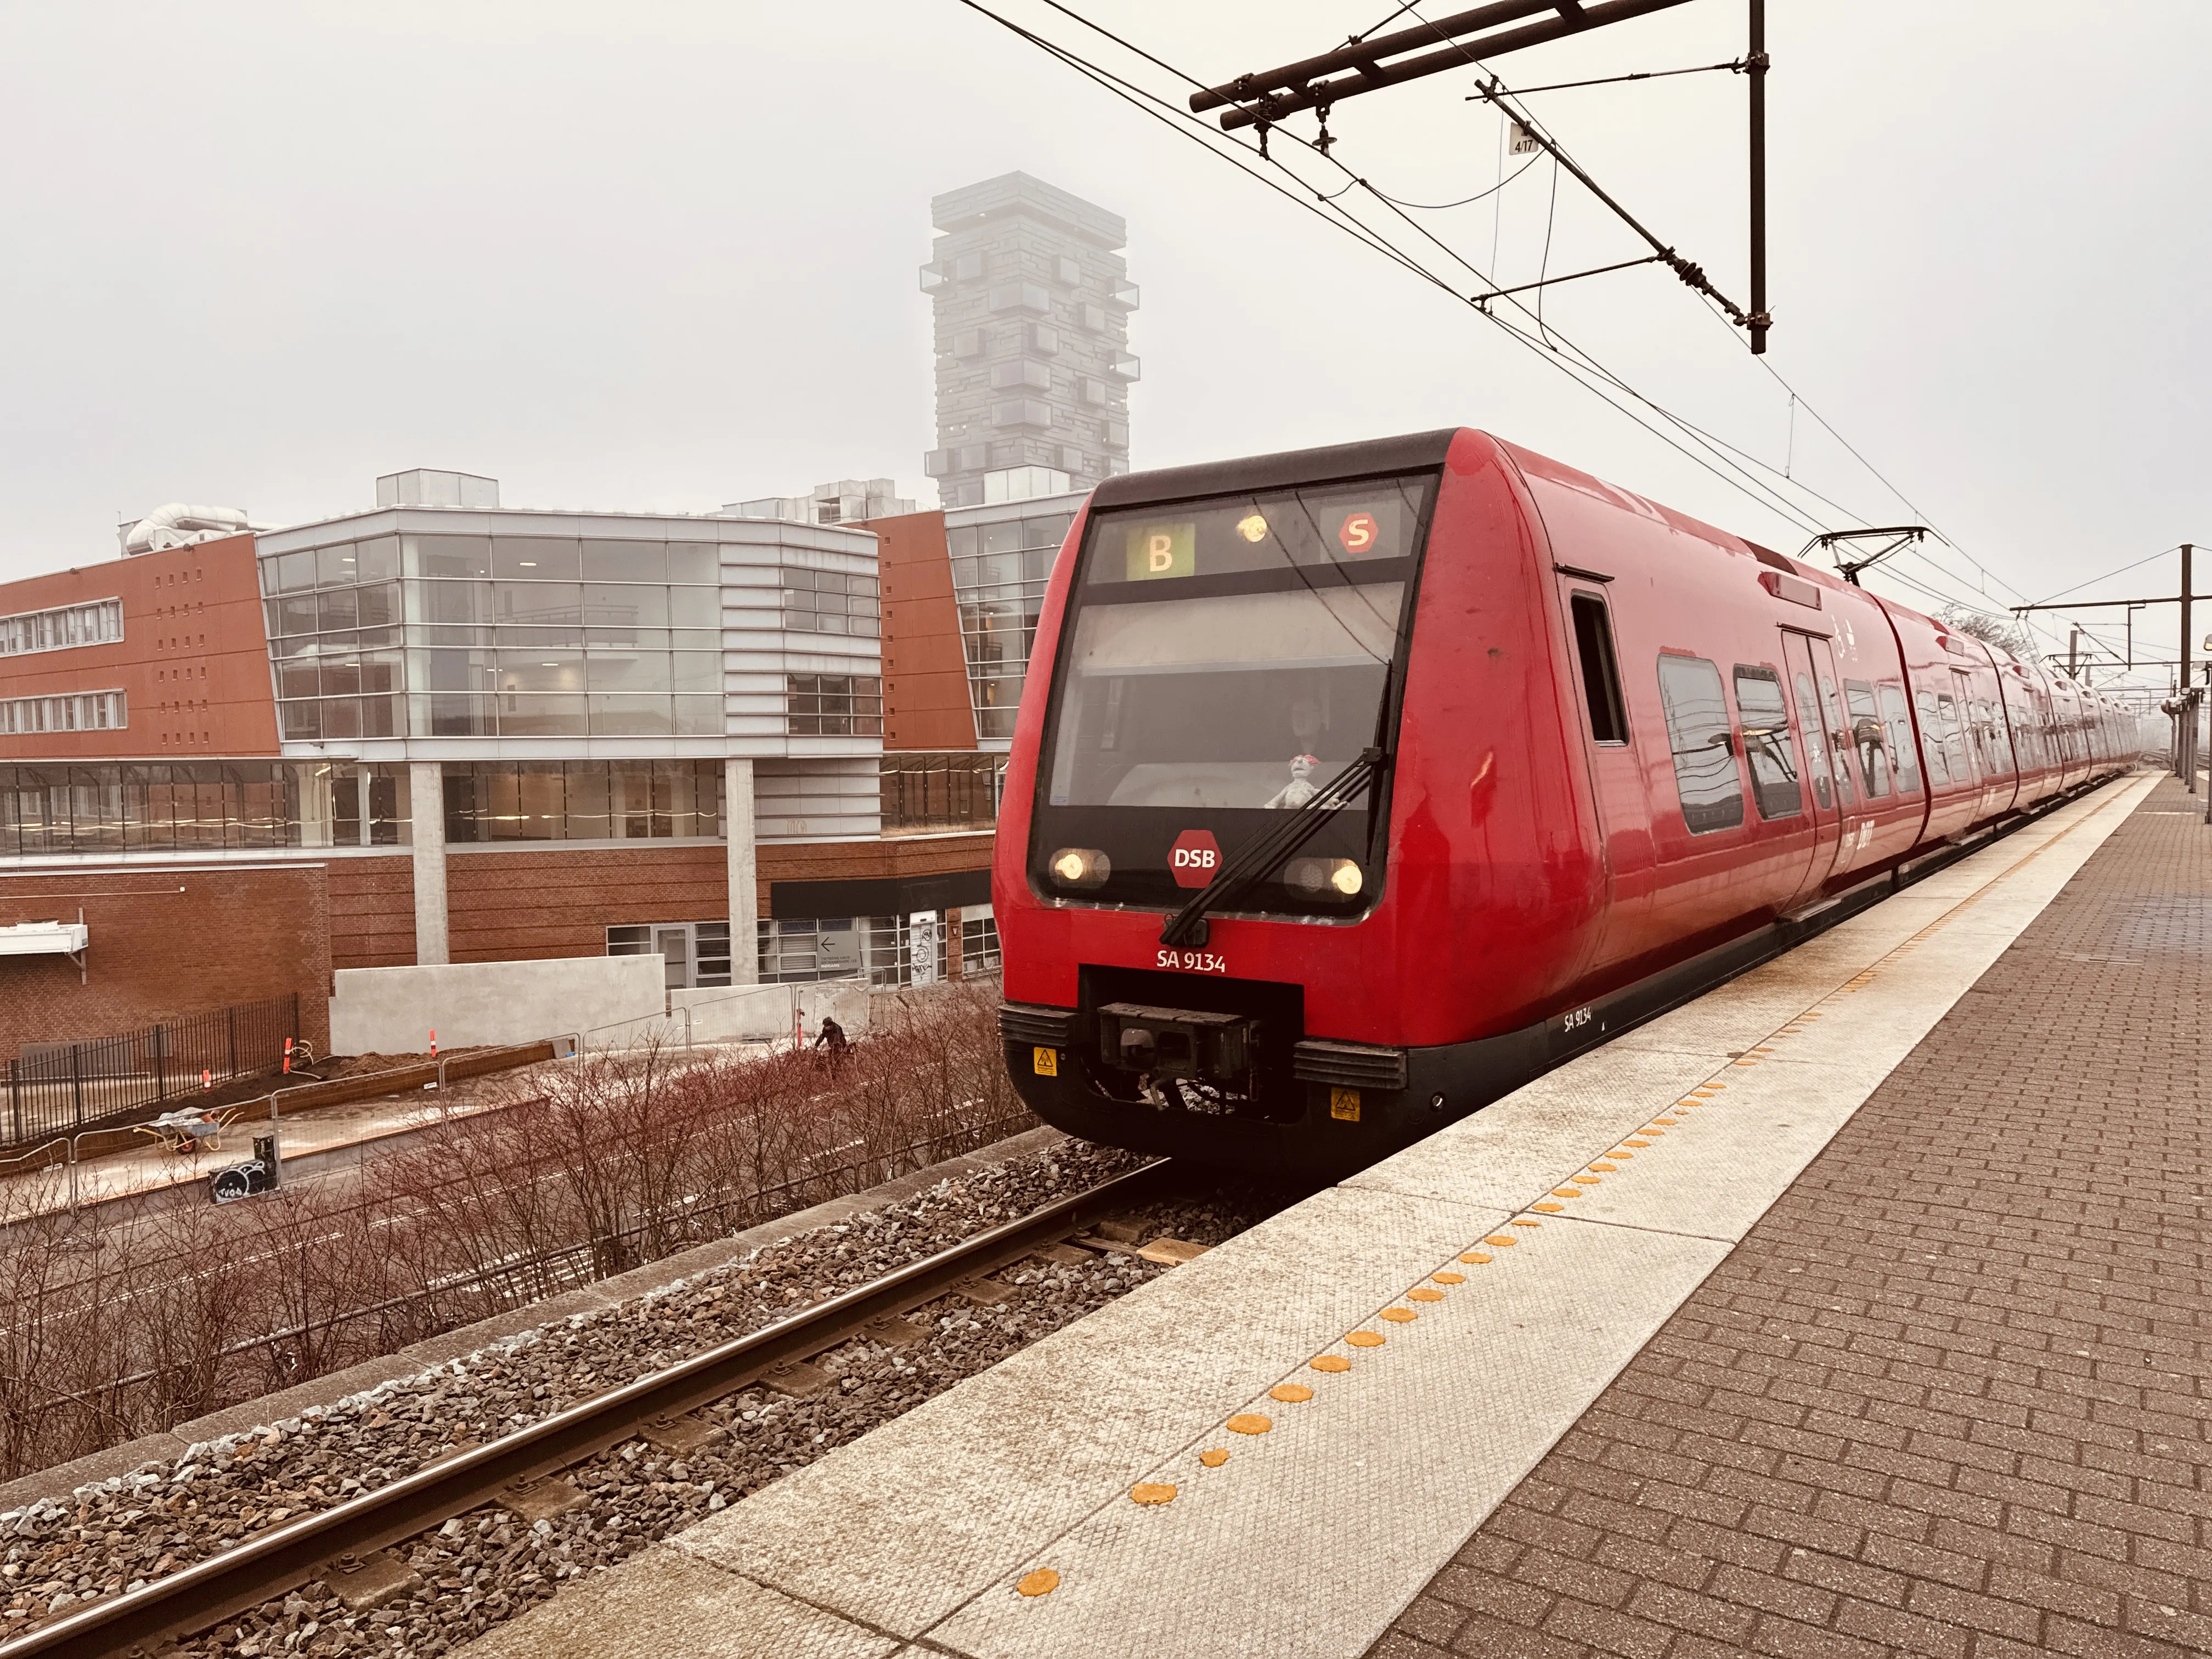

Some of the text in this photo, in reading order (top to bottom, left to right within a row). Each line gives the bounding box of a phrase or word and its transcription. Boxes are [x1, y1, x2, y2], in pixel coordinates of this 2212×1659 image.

[1515, 139, 1533, 153] 4/17
[1348, 519, 1370, 546] S
[1149, 535, 1173, 572] B
[1174, 849, 1215, 868] DSB
[1157, 950, 1225, 973] SA 9134
[1564, 1006, 1592, 1032] SA 9134
